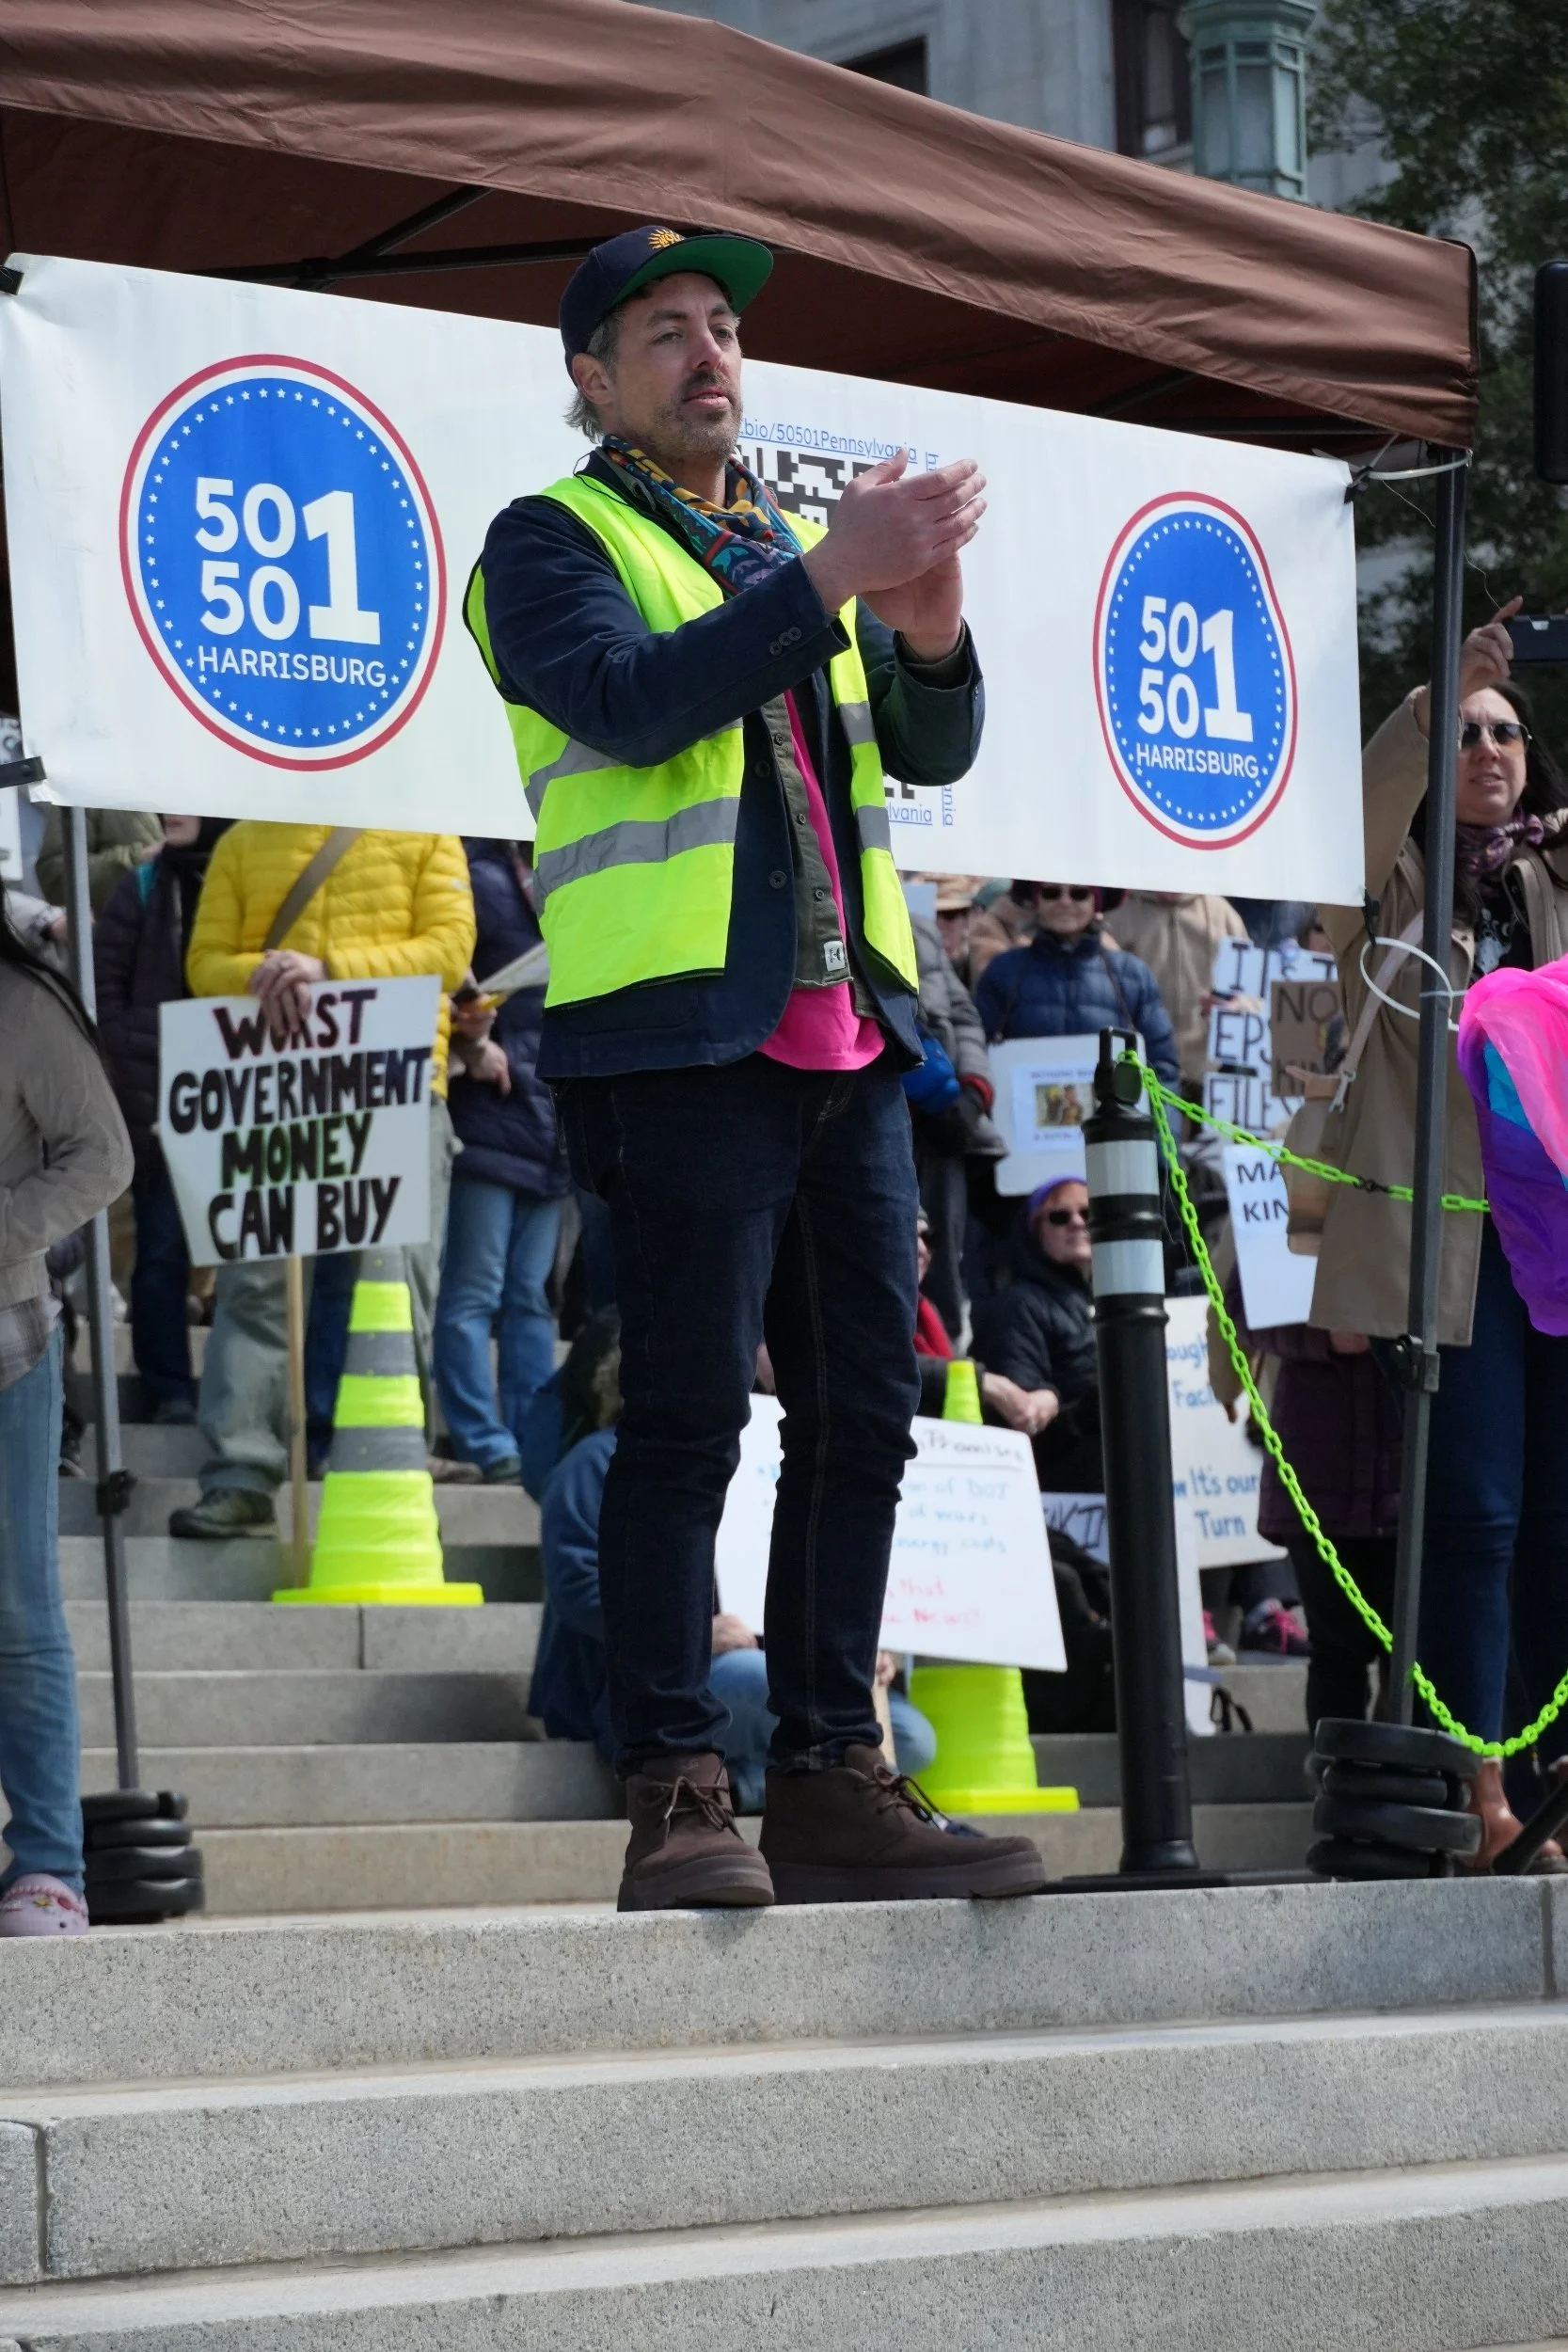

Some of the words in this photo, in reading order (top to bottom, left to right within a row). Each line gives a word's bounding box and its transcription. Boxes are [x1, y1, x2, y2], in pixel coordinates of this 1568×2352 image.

[195, 477, 296, 559] 50
[302, 490, 381, 645] 1
[200, 560, 301, 641] 50
[198, 645, 387, 688] HARRISBURG
[1139, 596, 1198, 668] 50
[1201, 609, 1254, 742] 1
[1137, 668, 1199, 739] 50
[1135, 742, 1259, 779] HARRISBURG
[1275, 985, 1338, 1023] NO
[168, 1046, 432, 1135] GOVERNMENT
[220, 1113, 373, 1189] MONEY
[209, 1184, 293, 1261] CAN
[317, 1177, 402, 1250] BUY
[1243, 1199, 1289, 1222] KIN
[1189, 1466, 1222, 1497] It's
[1227, 1474, 1258, 1495] our
[1194, 1509, 1246, 1539] Turn
